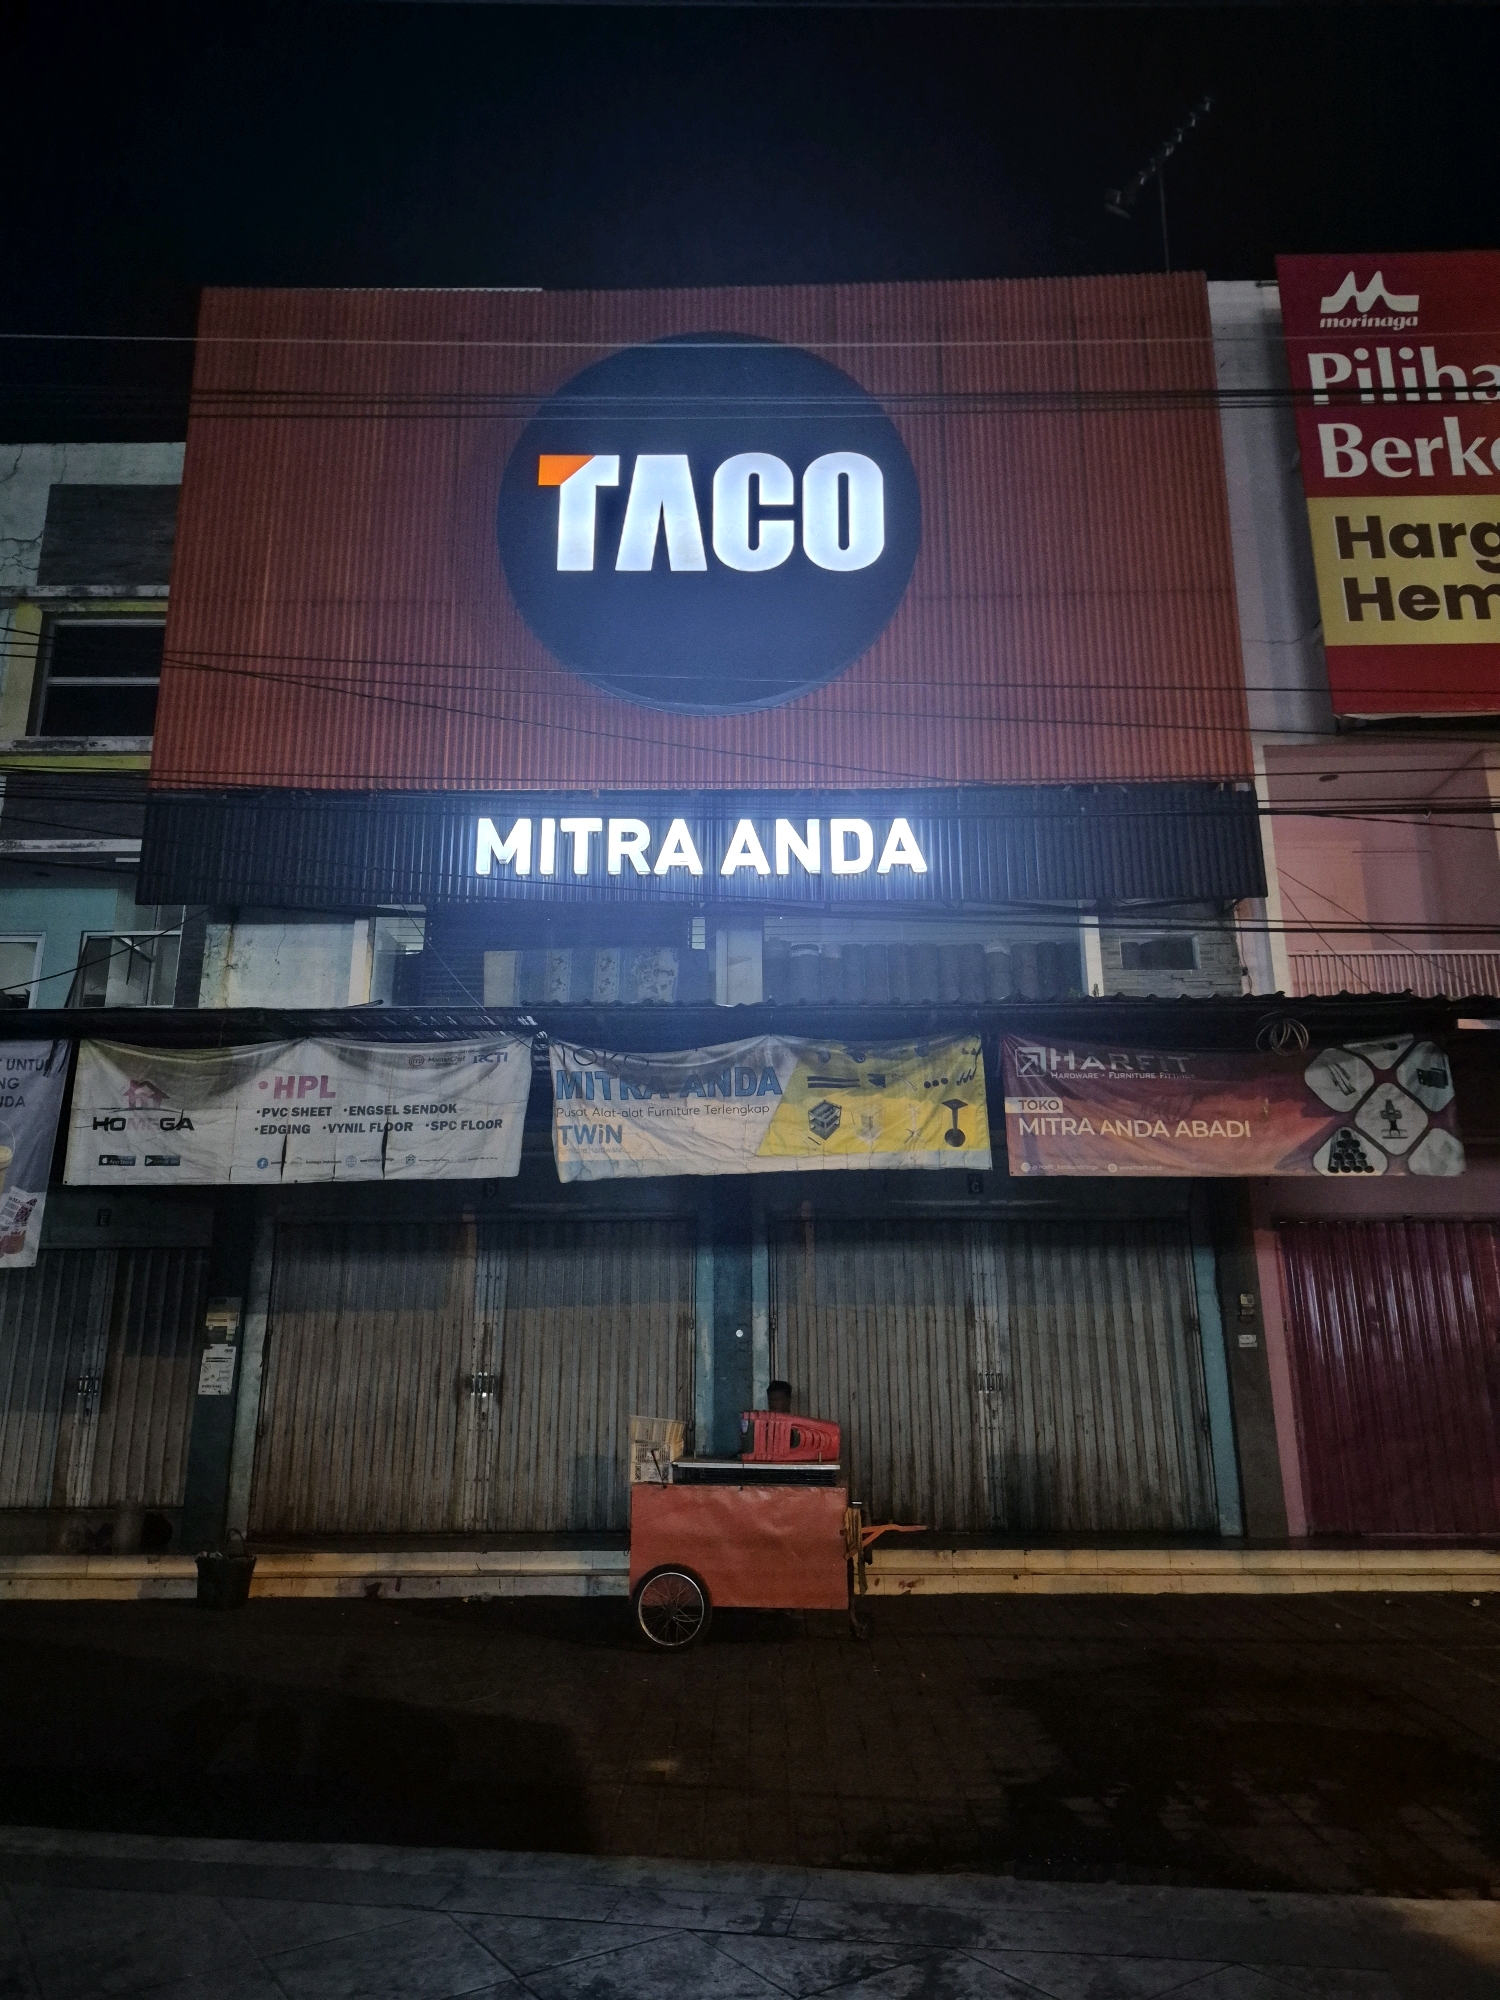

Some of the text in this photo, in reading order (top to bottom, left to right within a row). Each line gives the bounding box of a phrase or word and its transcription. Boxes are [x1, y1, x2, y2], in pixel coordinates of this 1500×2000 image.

[1319, 313, 1419, 331] morinaga
[1307, 346, 1500, 405] Piliha
[1317, 416, 1500, 478] Berk
[538, 451, 885, 572] TACO
[1334, 515, 1500, 574] Harg
[1343, 576, 1500, 621] Hem
[475, 817, 928, 876] MITRA ANDA
[7, 1058, 52, 1072] UNTU
[1049, 1047, 1191, 1073] HARFIT
[273, 1075, 336, 1099] HPL
[556, 1066, 783, 1101] MITRA ANDA
[261, 1104, 458, 1117] PVC SHEET ENGSEL SENDOK
[556, 1104, 770, 1118] Pusat Alat-alat Furniture Terlengkap
[1018, 1099, 1060, 1111] TOKO
[260, 1119, 504, 1135] EDGING VYNIL FLOOR SPC FLOOR
[1018, 1117, 1251, 1138] MITRA ANDA ABADI
